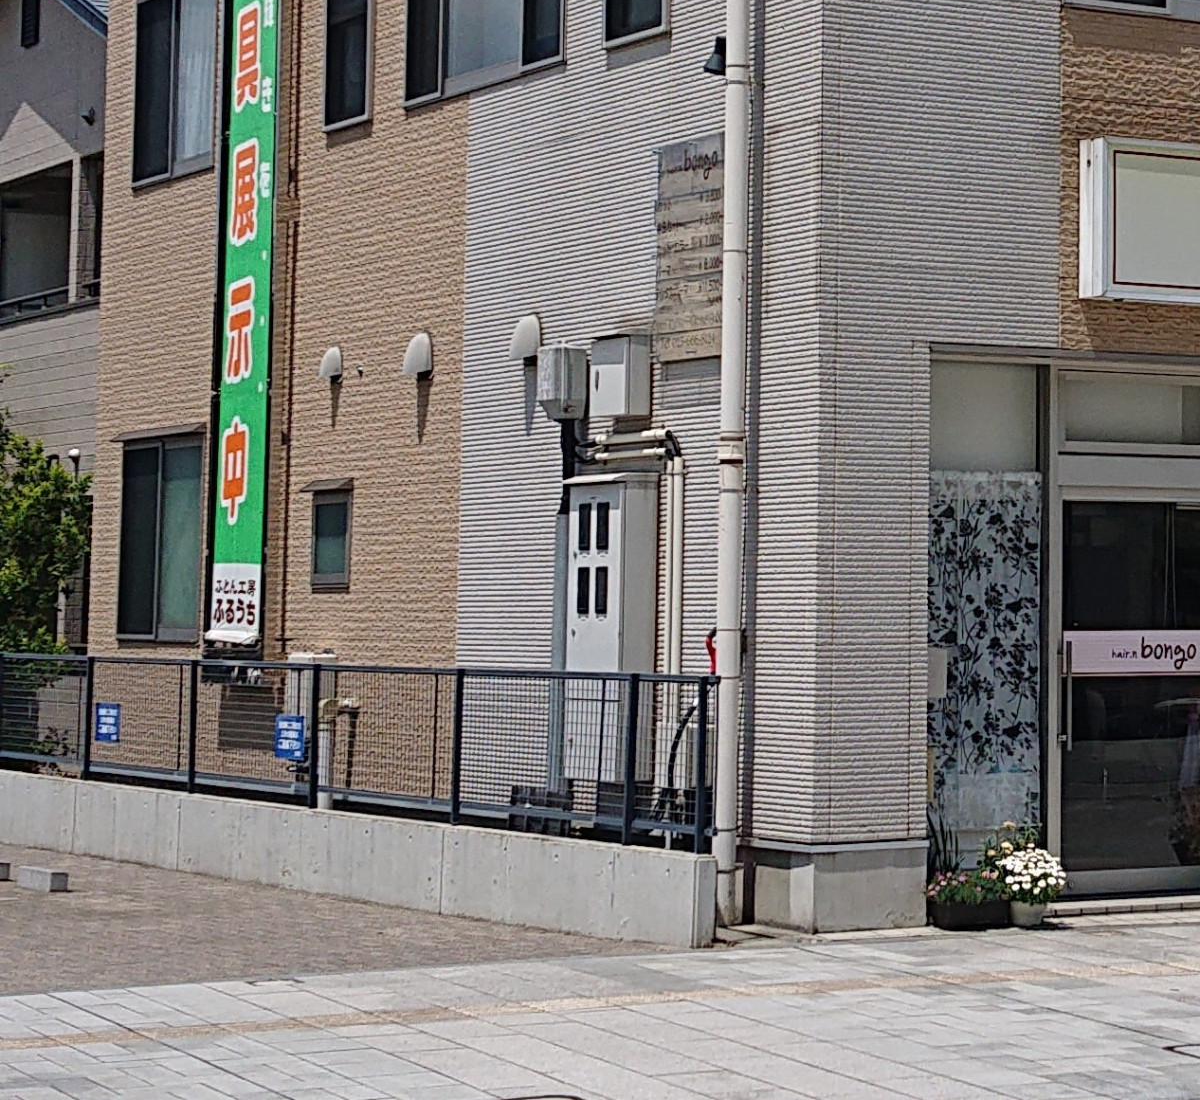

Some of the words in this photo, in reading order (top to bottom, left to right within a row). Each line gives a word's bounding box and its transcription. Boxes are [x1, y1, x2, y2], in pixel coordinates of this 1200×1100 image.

[214, 579, 257, 598] ふとん工房
[213, 598, 257, 626] ふるうち
[1140, 636, 1197, 670] bongo
